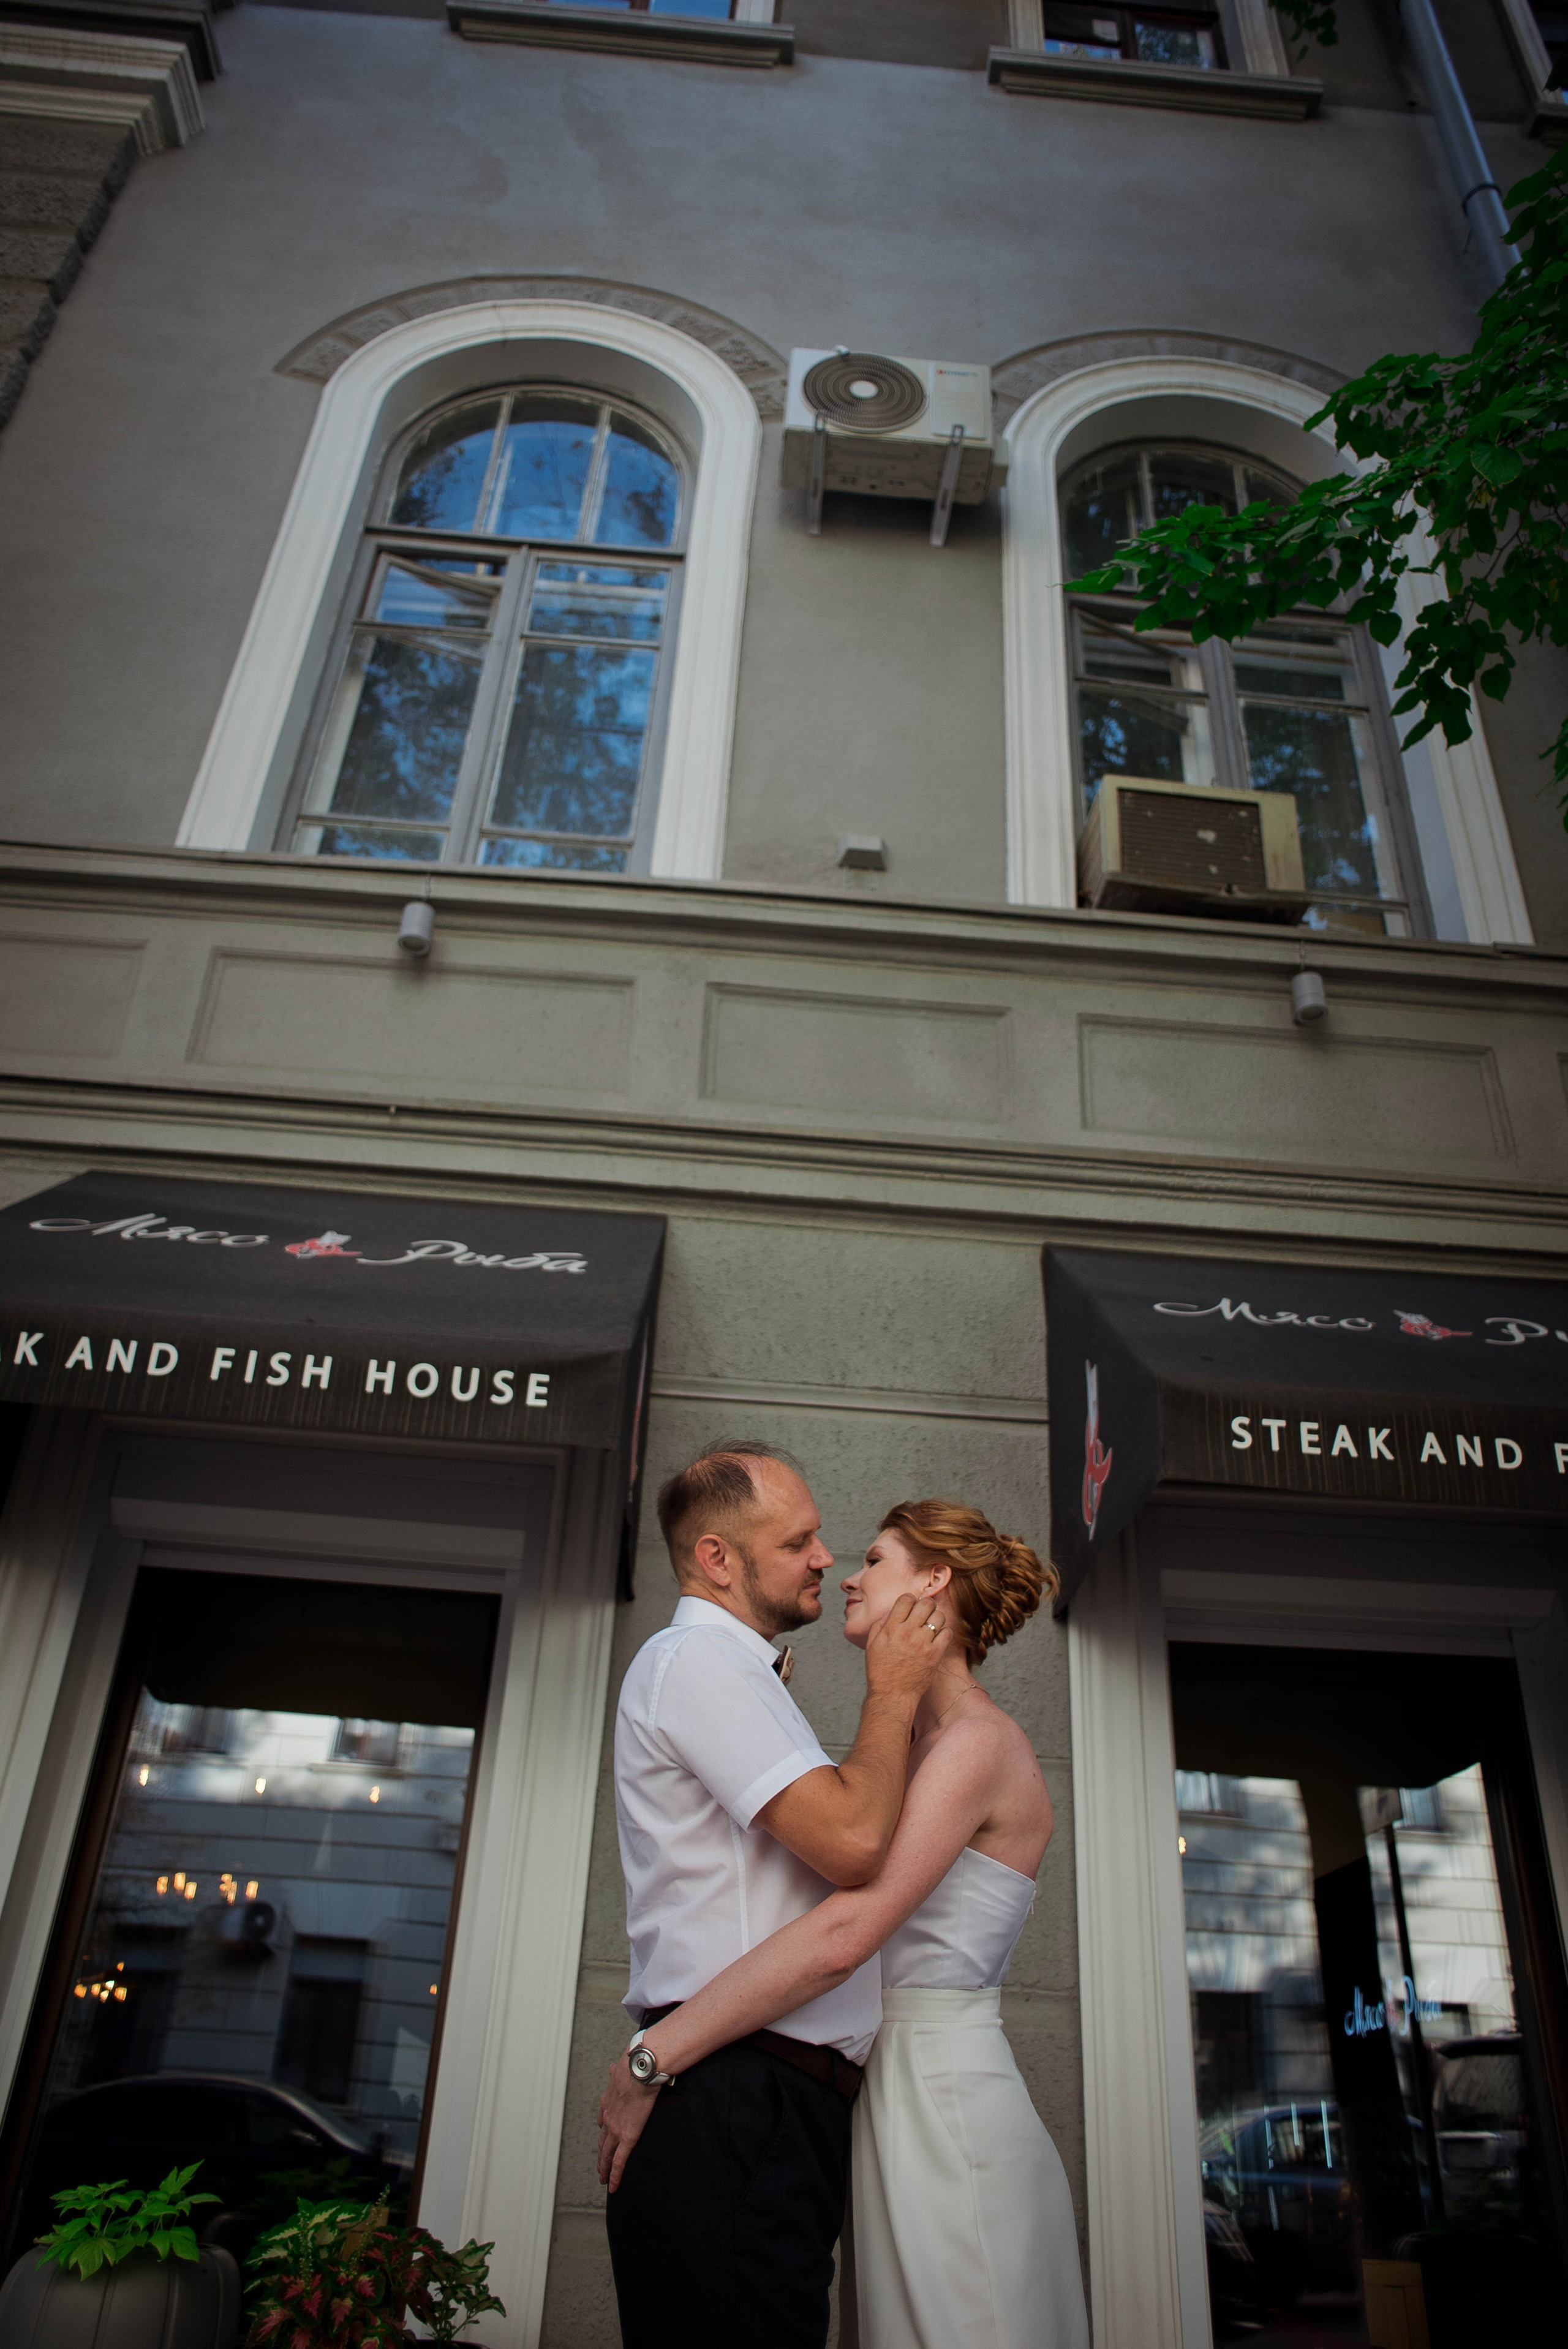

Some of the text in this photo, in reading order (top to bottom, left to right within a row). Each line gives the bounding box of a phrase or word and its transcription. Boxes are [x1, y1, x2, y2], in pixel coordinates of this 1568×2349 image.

[64, 1335, 179, 1376] AND
[209, 1346, 333, 1390] FISH
[364, 1358, 551, 1408] HOUSE
[1231, 1416, 1395, 1461] STEAK
[1420, 1431, 1523, 1469] AND
